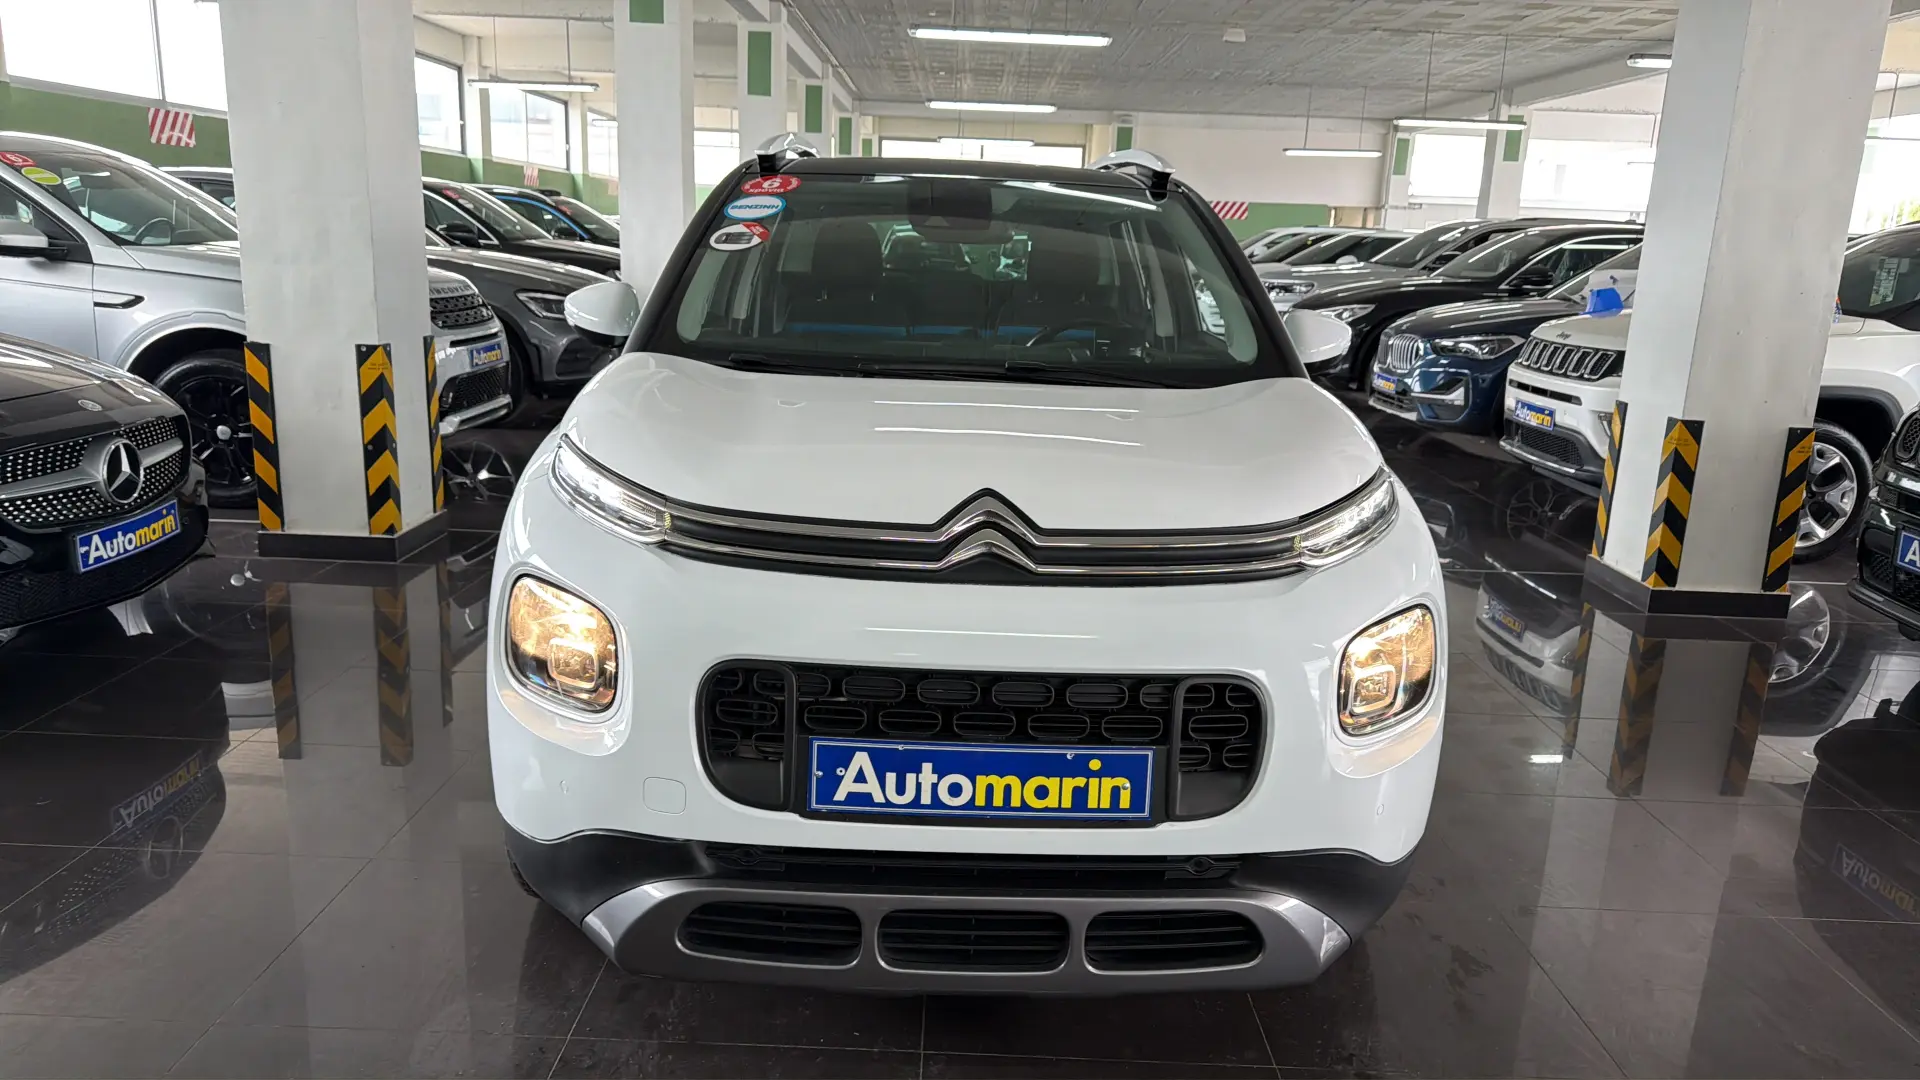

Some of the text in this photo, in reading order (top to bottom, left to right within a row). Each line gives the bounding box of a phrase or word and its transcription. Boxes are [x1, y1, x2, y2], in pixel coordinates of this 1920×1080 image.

[762, 178, 783, 189] 6
[1515, 402, 1552, 427] Automarin
[87, 508, 176, 565] Automarin
[832, 751, 1131, 809] Automarin
